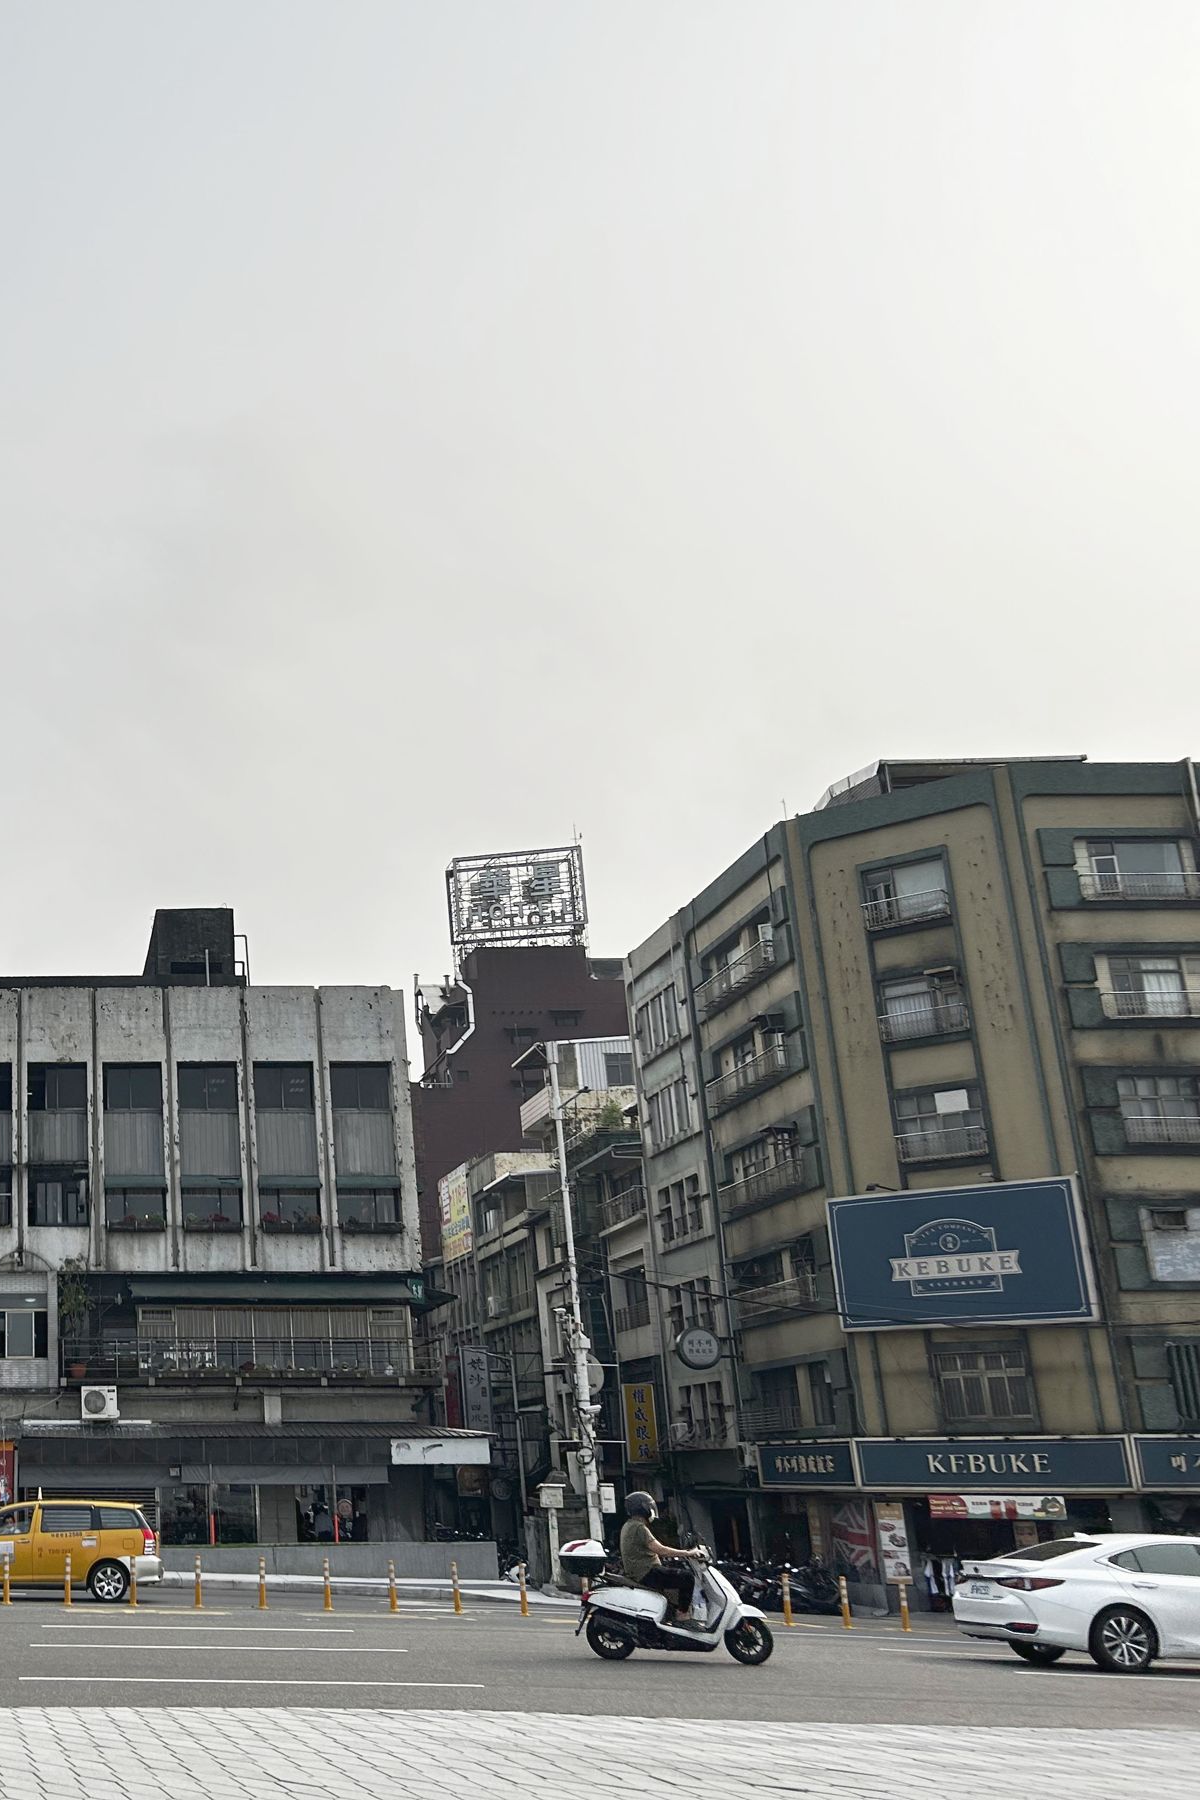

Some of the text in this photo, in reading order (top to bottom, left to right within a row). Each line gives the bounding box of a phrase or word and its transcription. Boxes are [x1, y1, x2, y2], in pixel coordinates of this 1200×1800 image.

[467, 898, 574, 922] HOTEL
[896, 1255, 1013, 1277] KEBUKE
[927, 1453, 1052, 1474] KEBUKE
